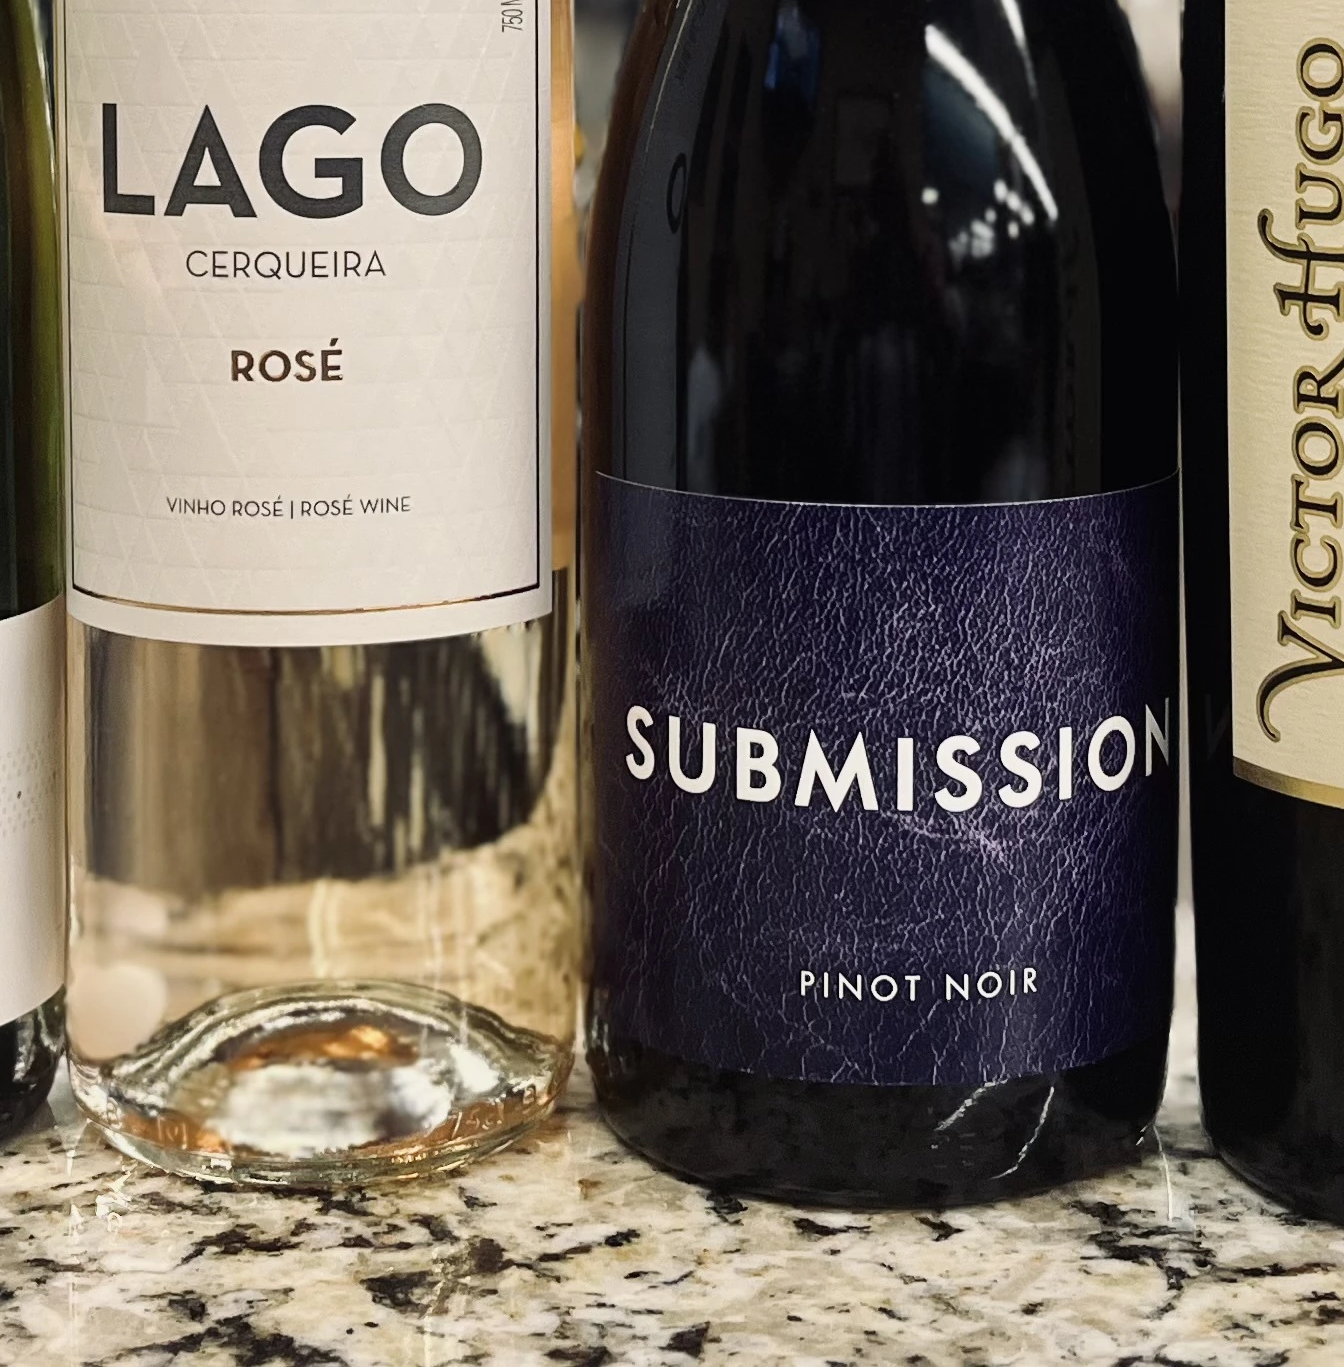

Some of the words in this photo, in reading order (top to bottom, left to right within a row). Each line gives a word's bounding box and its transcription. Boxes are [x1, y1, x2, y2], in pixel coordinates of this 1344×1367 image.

[501, 8, 523, 33] 750
[101, 102, 483, 219] LAGO
[185, 249, 387, 280] CERQUEIRA
[230, 338, 345, 384] ROSÉ
[166, 496, 226, 516] VINHO
[232, 494, 284, 517] ROSÉ
[301, 493, 354, 516] ROSÉ
[359, 495, 411, 514] WINE
[625, 697, 1171, 814] SUBMISSION
[800, 970, 922, 1002] PINOT
[945, 967, 1038, 1001] NOIR
